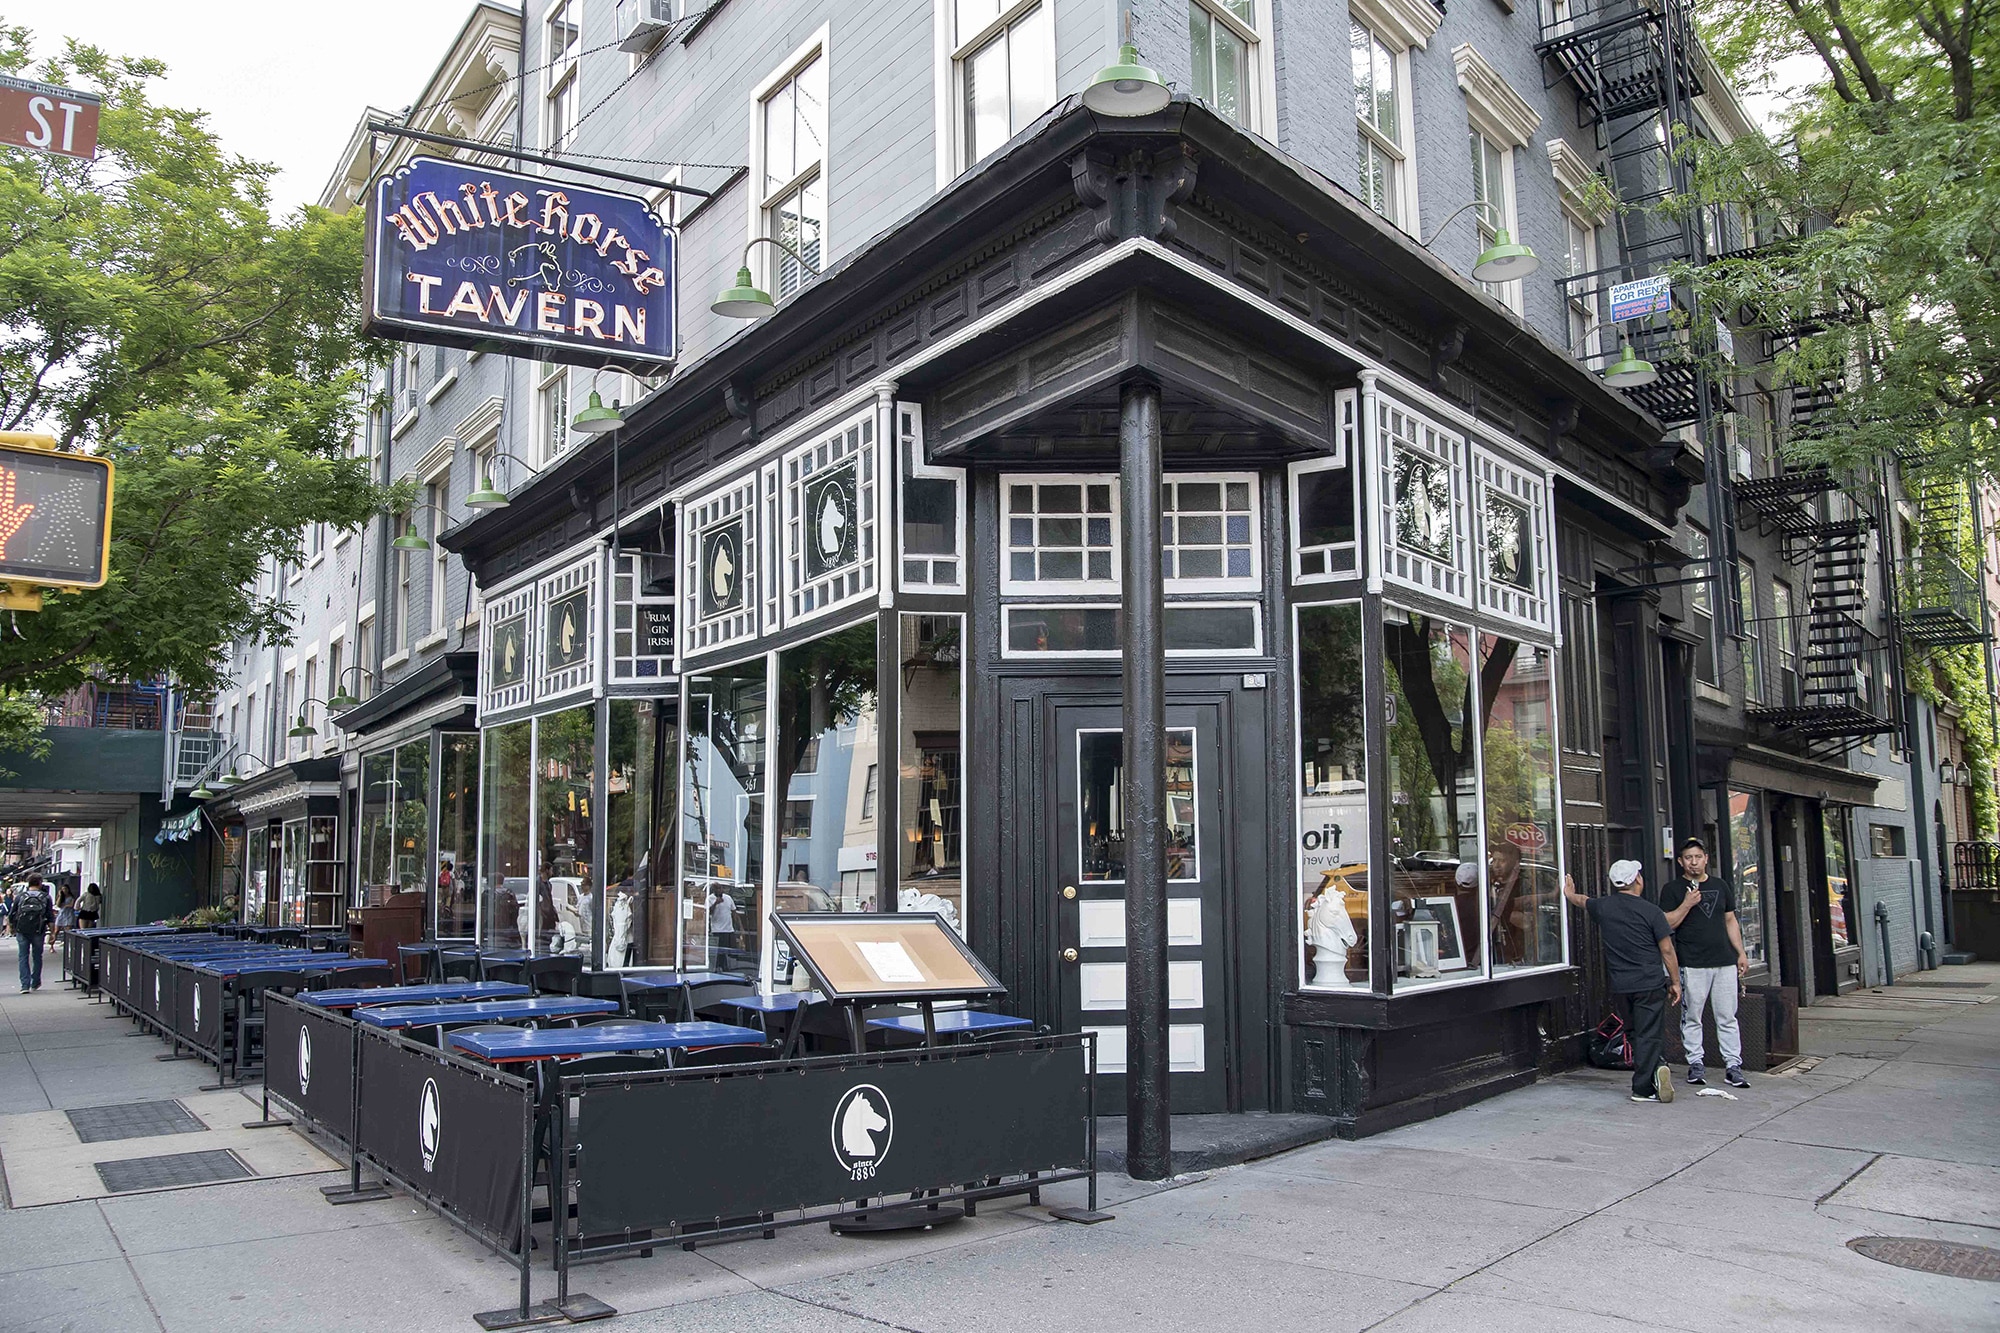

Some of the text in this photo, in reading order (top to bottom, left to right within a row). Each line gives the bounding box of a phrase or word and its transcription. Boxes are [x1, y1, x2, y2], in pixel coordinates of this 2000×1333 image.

[36, 85, 78, 99] DISTRICT
[25, 96, 83, 151] ST
[385, 180, 530, 252] White
[1613, 290, 1635, 303] FOR
[406, 272, 647, 345] TAVERN
[650, 613, 671, 622] RUM
[651, 625, 669, 634] GIN
[647, 637, 674, 646] IRISH
[853, 1160, 873, 1169] since
[850, 1165, 876, 1181] 1880
